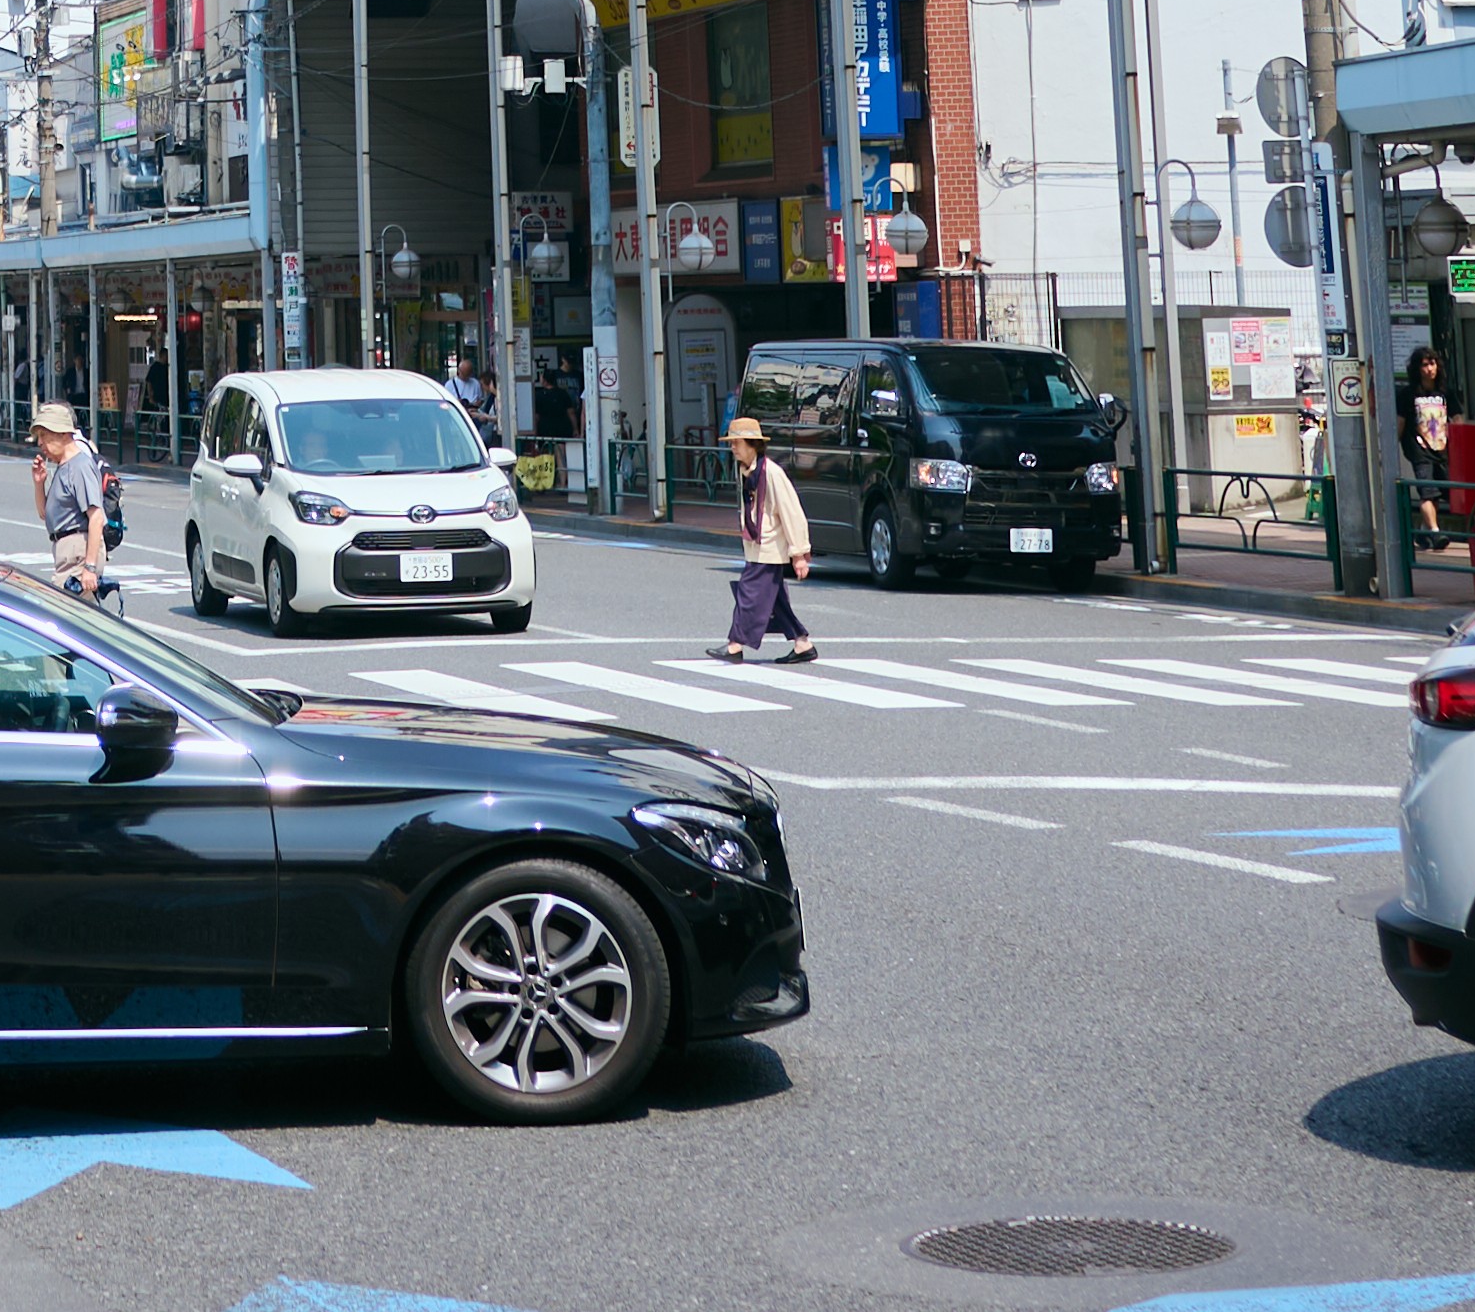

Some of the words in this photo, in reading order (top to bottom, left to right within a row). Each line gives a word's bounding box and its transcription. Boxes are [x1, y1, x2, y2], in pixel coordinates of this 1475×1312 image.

[615, 215, 729, 262] 大東信用組合
